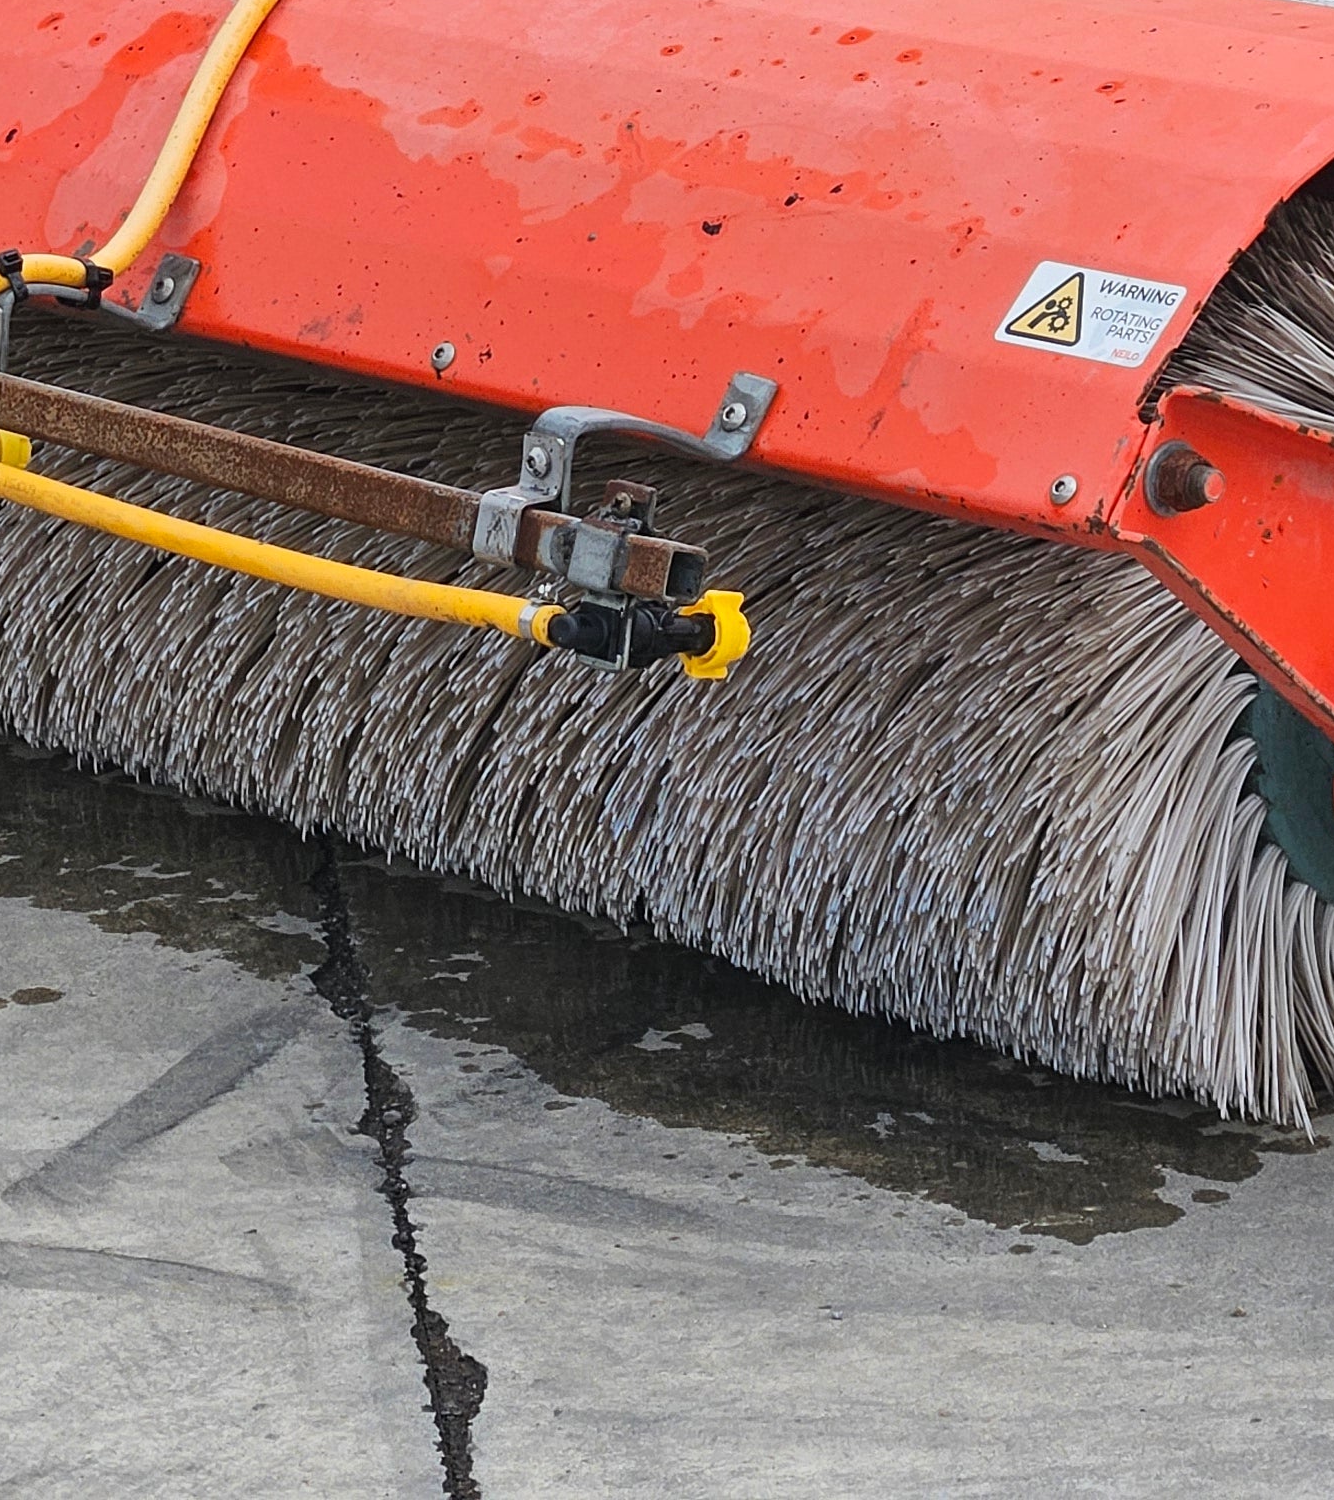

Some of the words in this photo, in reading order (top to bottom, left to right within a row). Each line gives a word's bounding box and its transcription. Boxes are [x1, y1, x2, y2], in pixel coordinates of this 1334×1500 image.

[1099, 279, 1179, 307] WARNING
[1090, 306, 1163, 331] ROTATING
[1105, 324, 1156, 345] PARTS!
[1111, 349, 1140, 361] NEILO
